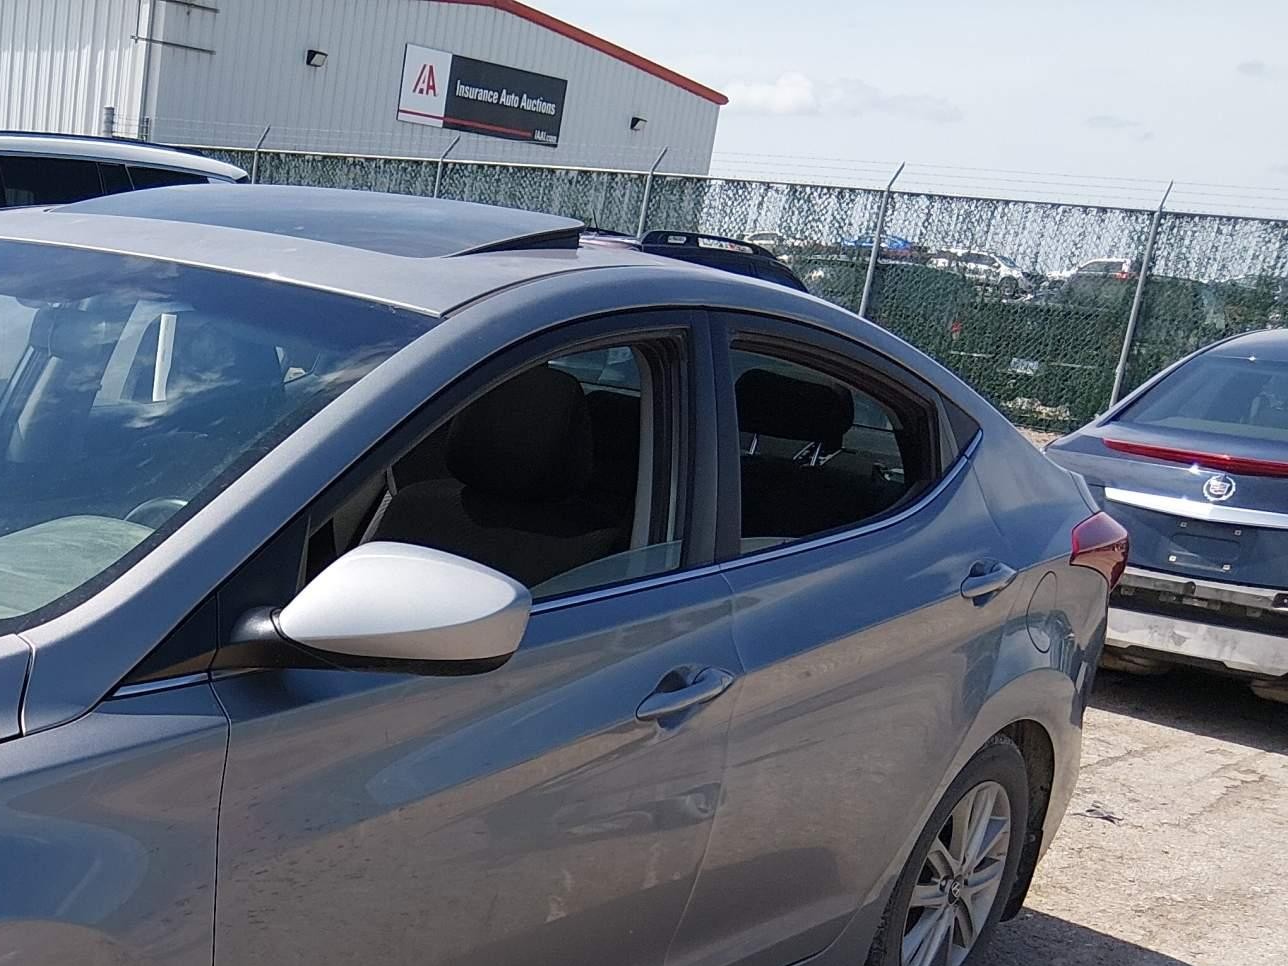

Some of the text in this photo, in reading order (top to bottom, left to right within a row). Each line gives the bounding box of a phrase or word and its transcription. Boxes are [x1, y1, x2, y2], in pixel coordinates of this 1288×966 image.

[456, 80, 557, 116] Insurance Auto Auctions
